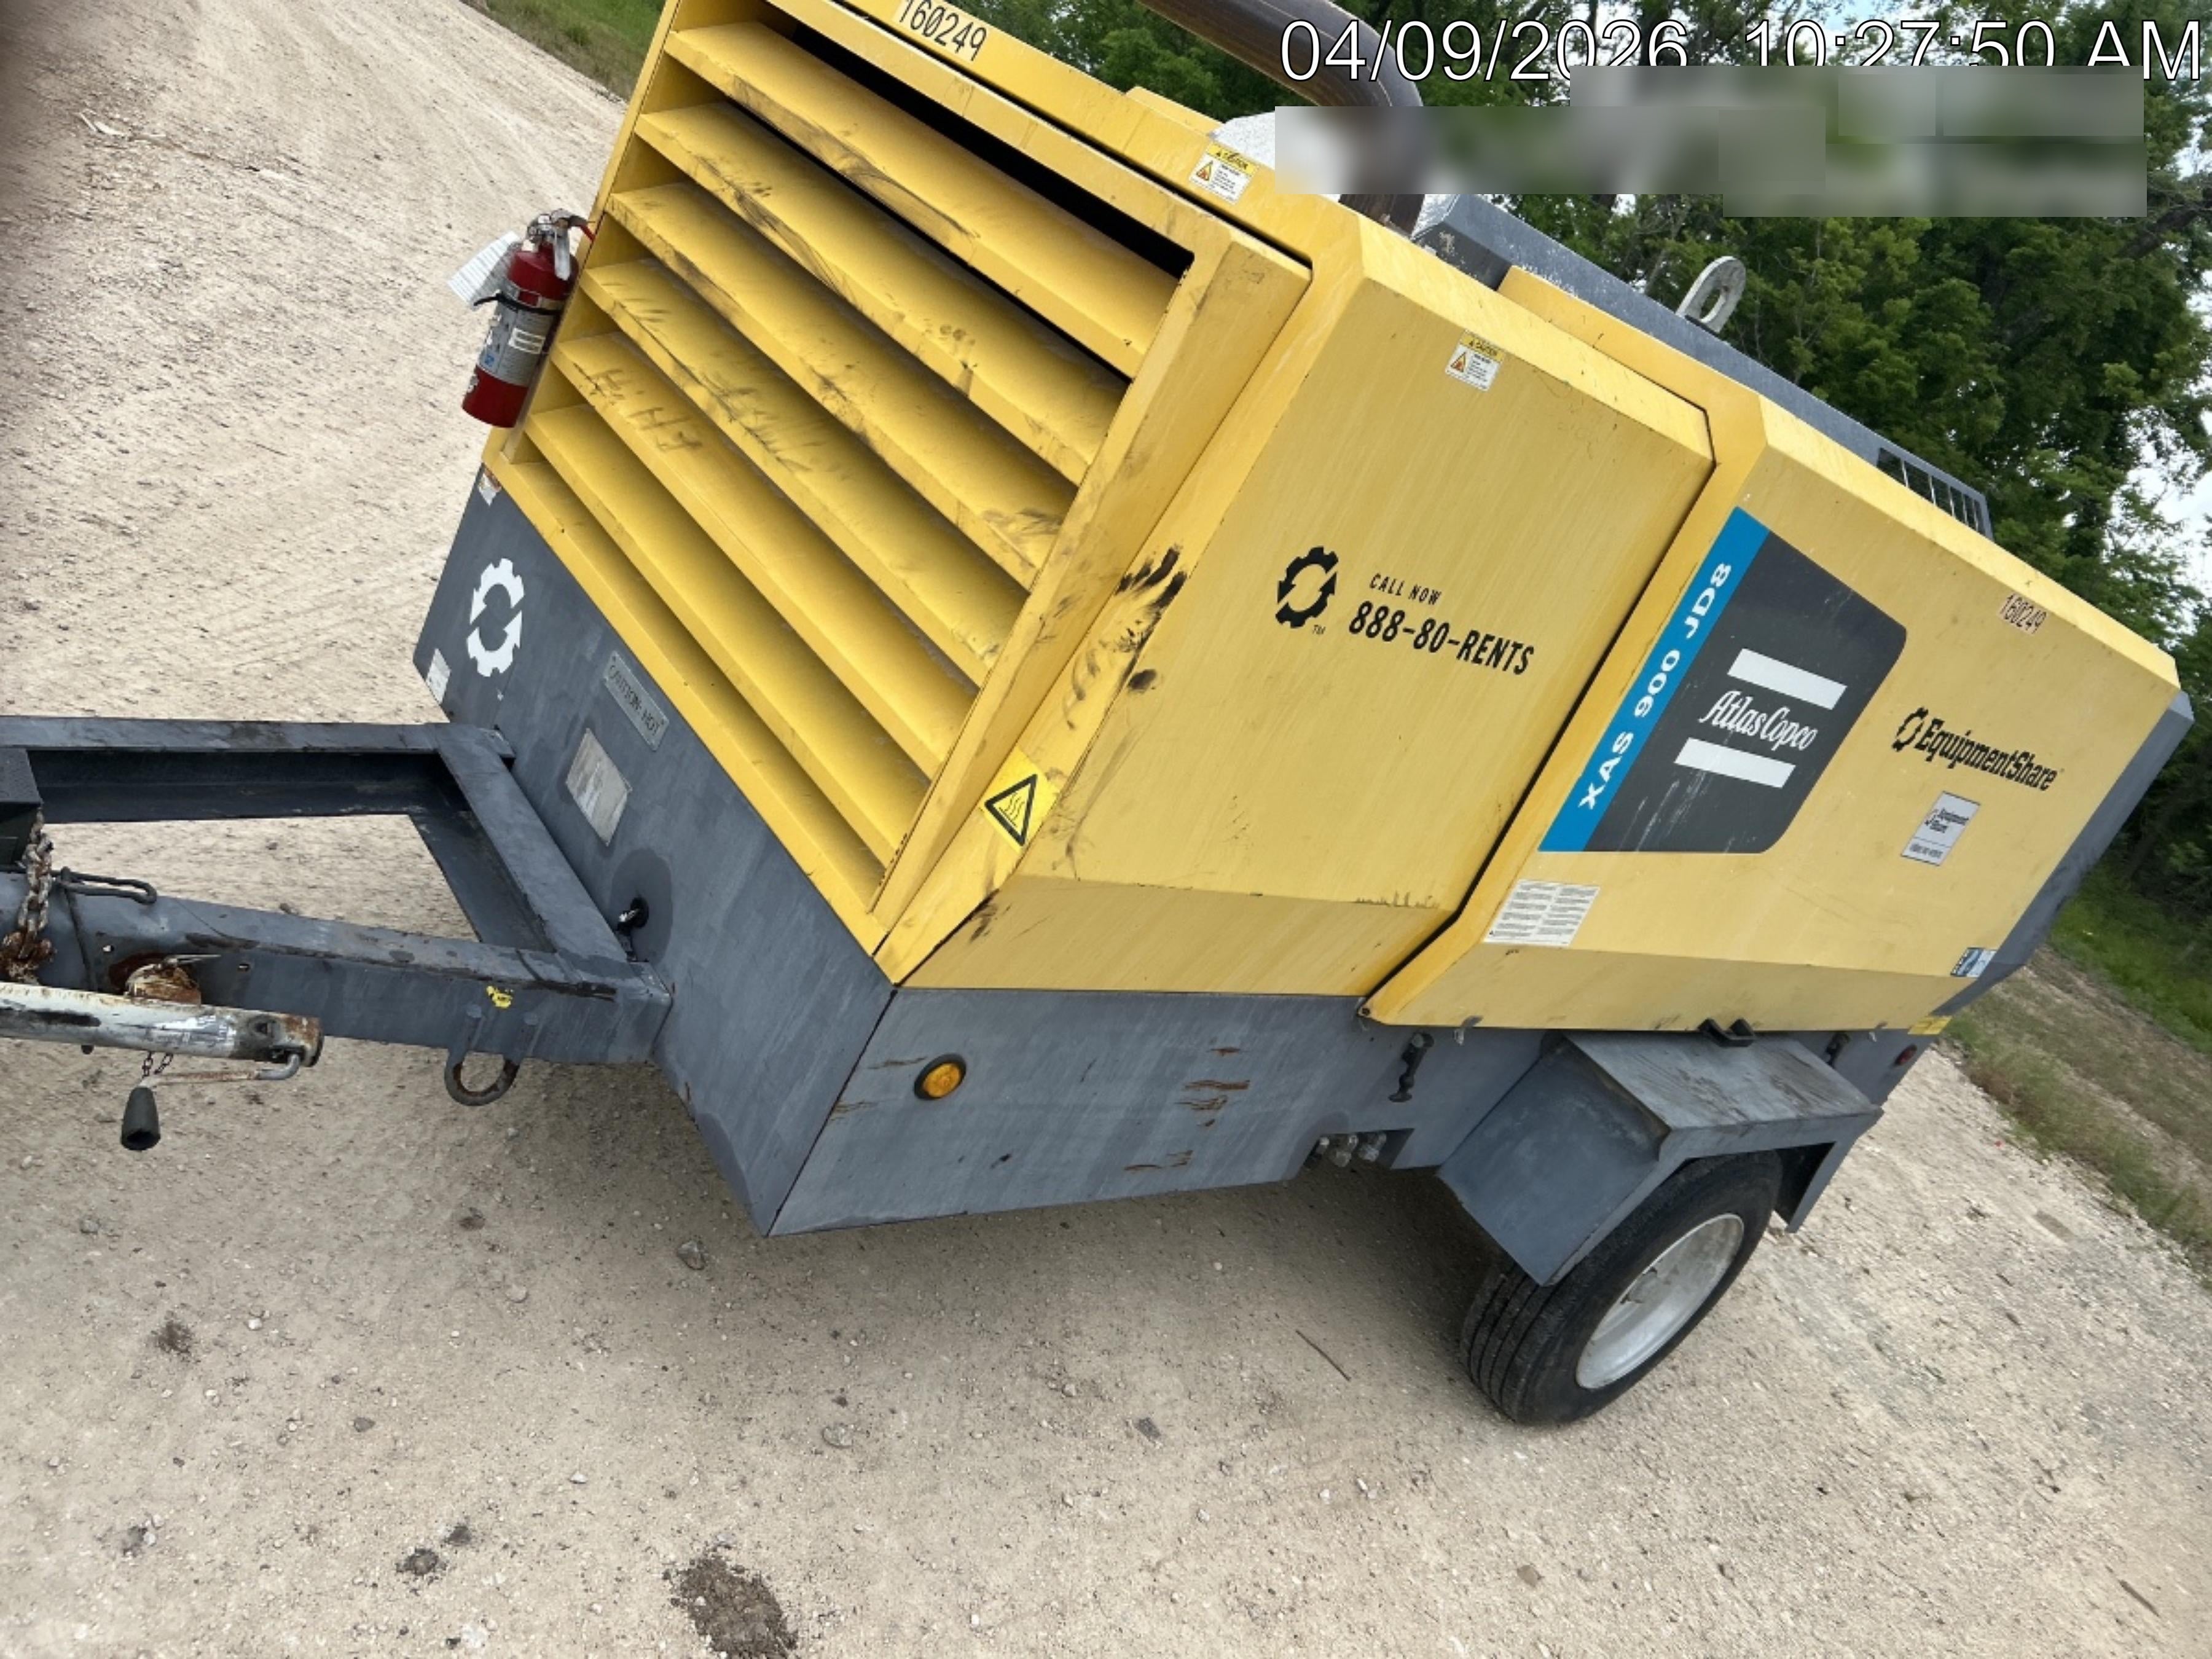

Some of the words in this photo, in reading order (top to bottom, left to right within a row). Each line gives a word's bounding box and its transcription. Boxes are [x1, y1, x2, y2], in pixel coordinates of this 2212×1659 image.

[900, 0, 987, 61] 160249
[1369, 573, 1406, 597] CALL
[1408, 584, 1442, 605] NOW
[1999, 592, 2047, 635] 160249
[1349, 600, 1534, 675] 888-80-RENTS
[1578, 731, 1634, 810] XAS
[1634, 649, 1681, 718] 900
[1685, 562, 1732, 639] JD8
[1913, 717, 2058, 791] EquipmentShare
